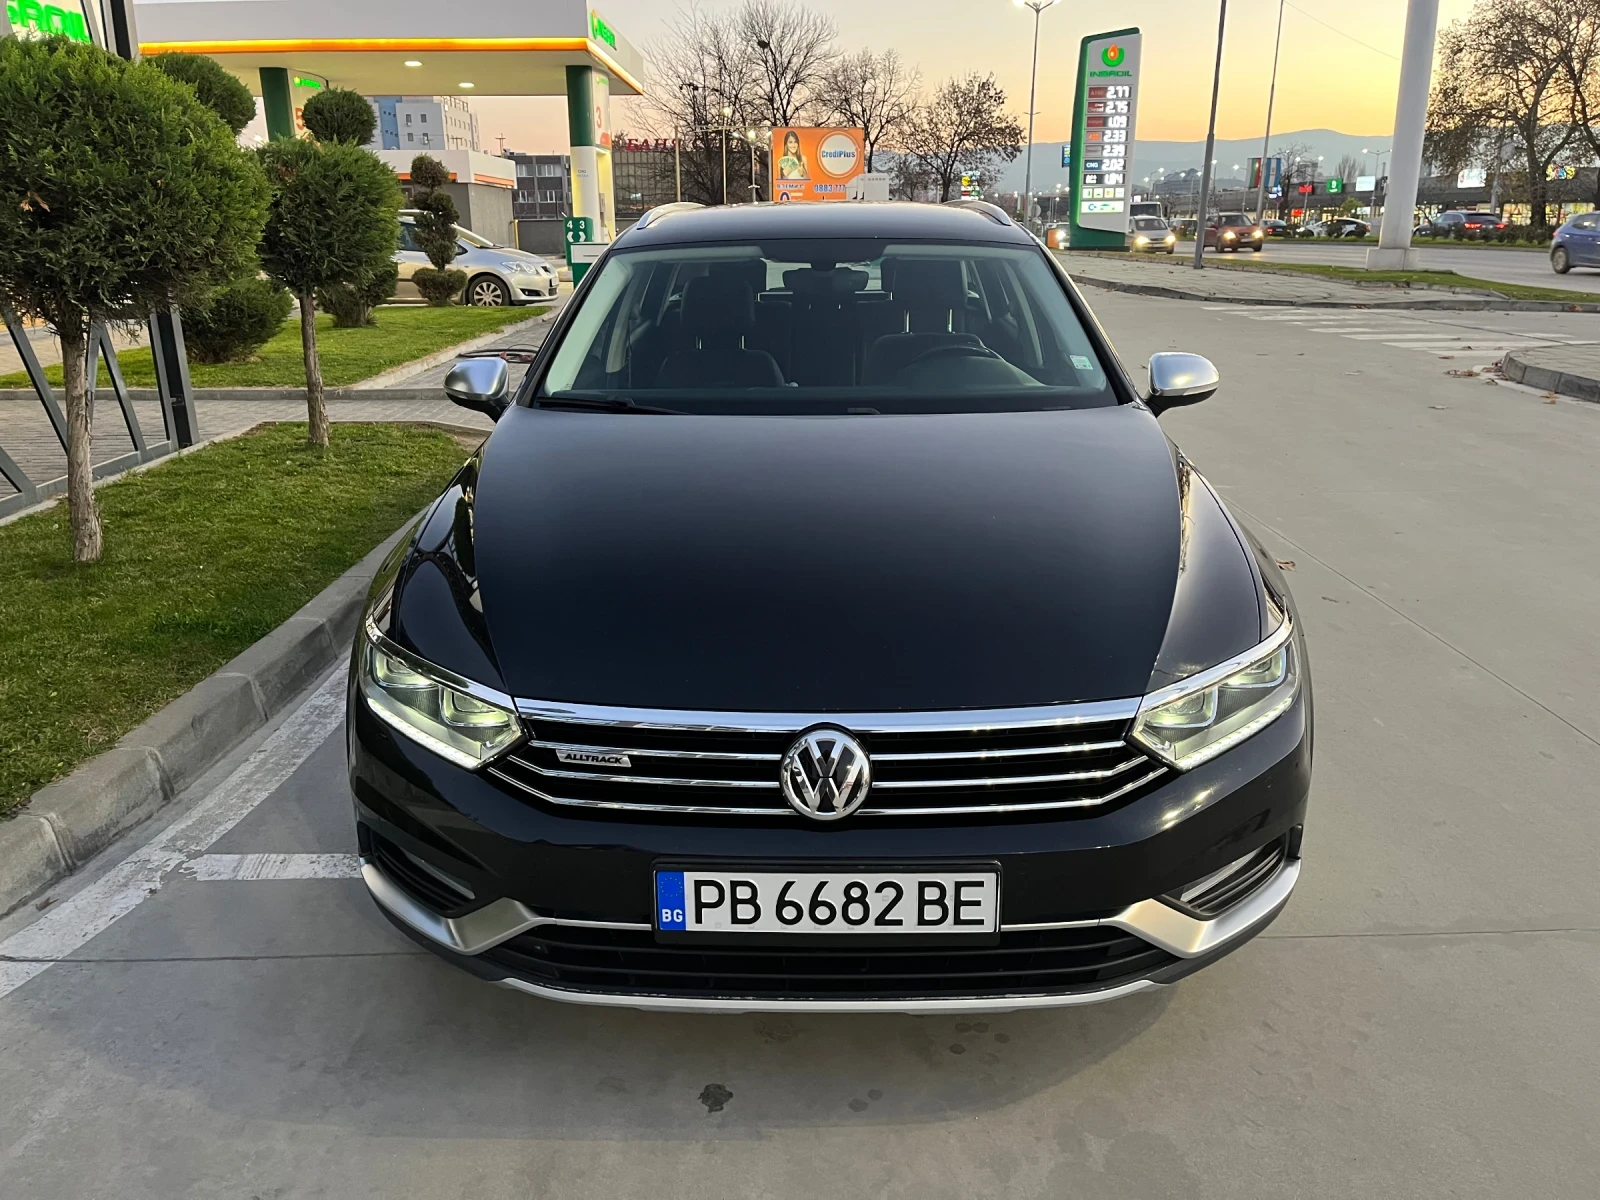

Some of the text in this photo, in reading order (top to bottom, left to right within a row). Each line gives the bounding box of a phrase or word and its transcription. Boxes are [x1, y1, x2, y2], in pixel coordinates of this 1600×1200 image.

[595, 106, 602, 128] 3
[1103, 130, 1126, 142] 2.33
[821, 150, 855, 158] CrediPlus
[814, 184, 833, 192] 0883
[567, 220, 585, 229] 4 3
[565, 753, 623, 764] ALLTRACK
[694, 879, 985, 926] PB 6682 BE
[661, 909, 683, 922] BG
